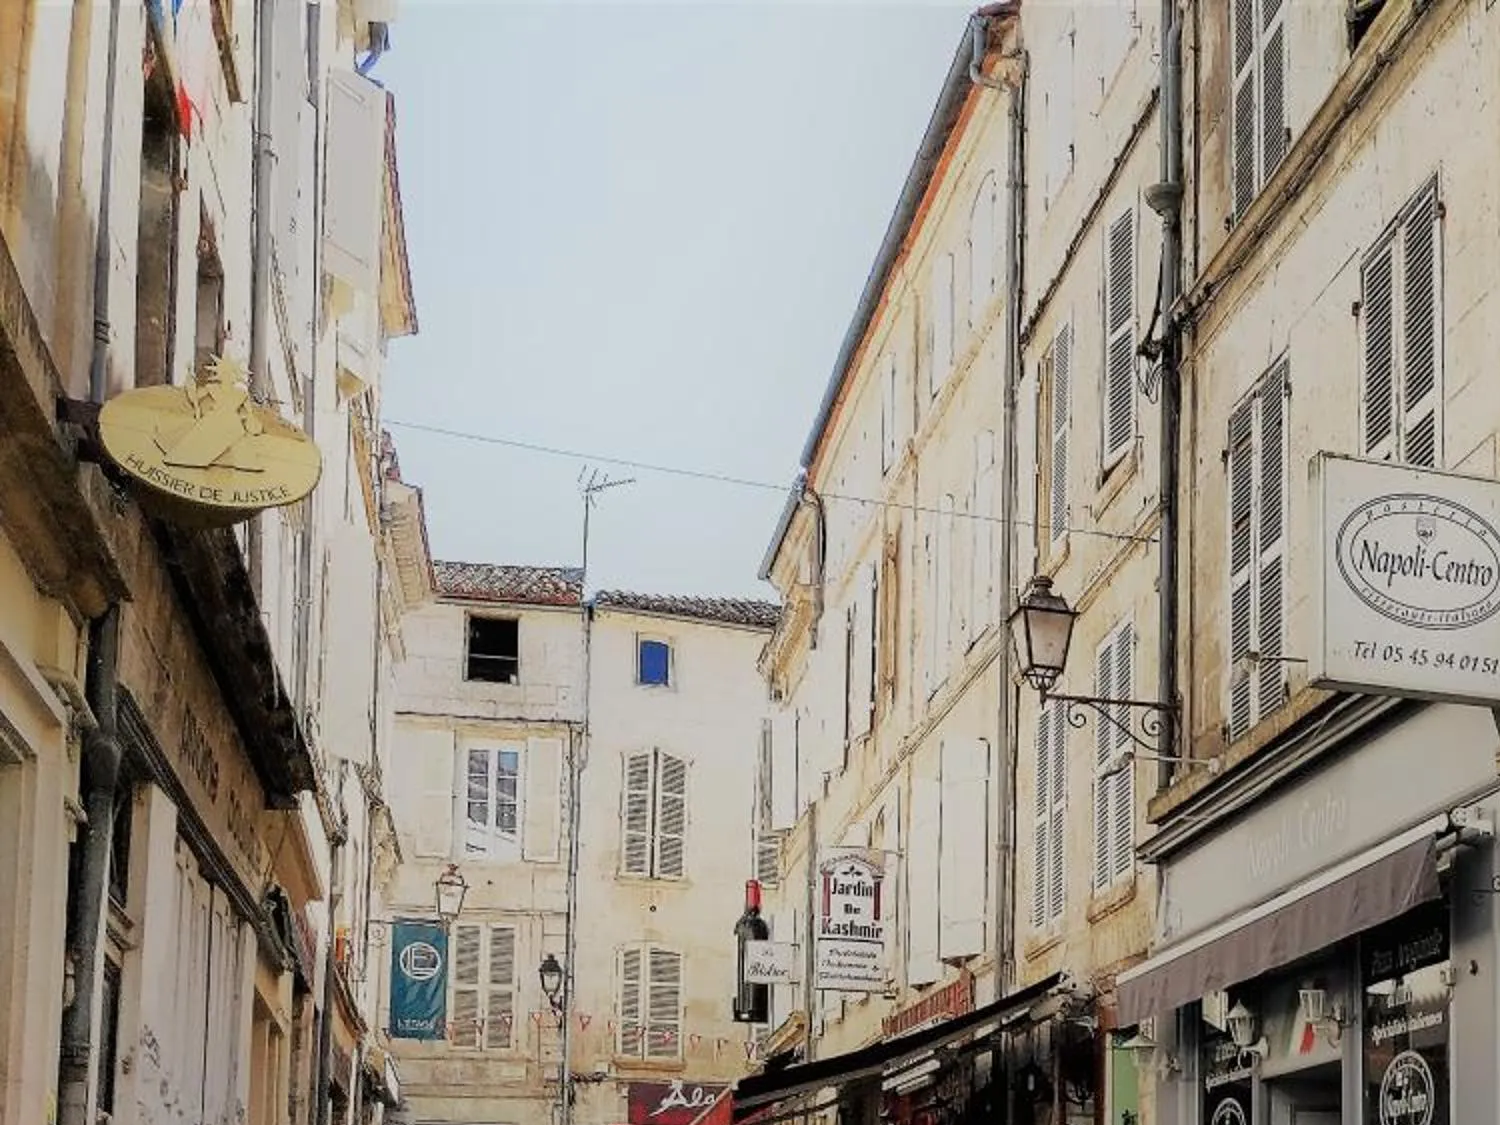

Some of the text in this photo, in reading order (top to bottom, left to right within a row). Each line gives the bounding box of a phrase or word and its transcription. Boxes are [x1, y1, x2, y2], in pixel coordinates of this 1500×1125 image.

[125, 453, 290, 503] HUISSIER DE JUSTICE
[1359, 539, 1493, 588] Napoli-Centro
[1384, 645, 1403, 663] 05
[1409, 648, 1428, 666] 45
[1434, 653, 1455, 669] 94
[1460, 655, 1479, 672] 01
[1482, 657, 1499, 674] 51
[831, 877, 873, 898] Jardin
[821, 917, 883, 939] Kashmir
